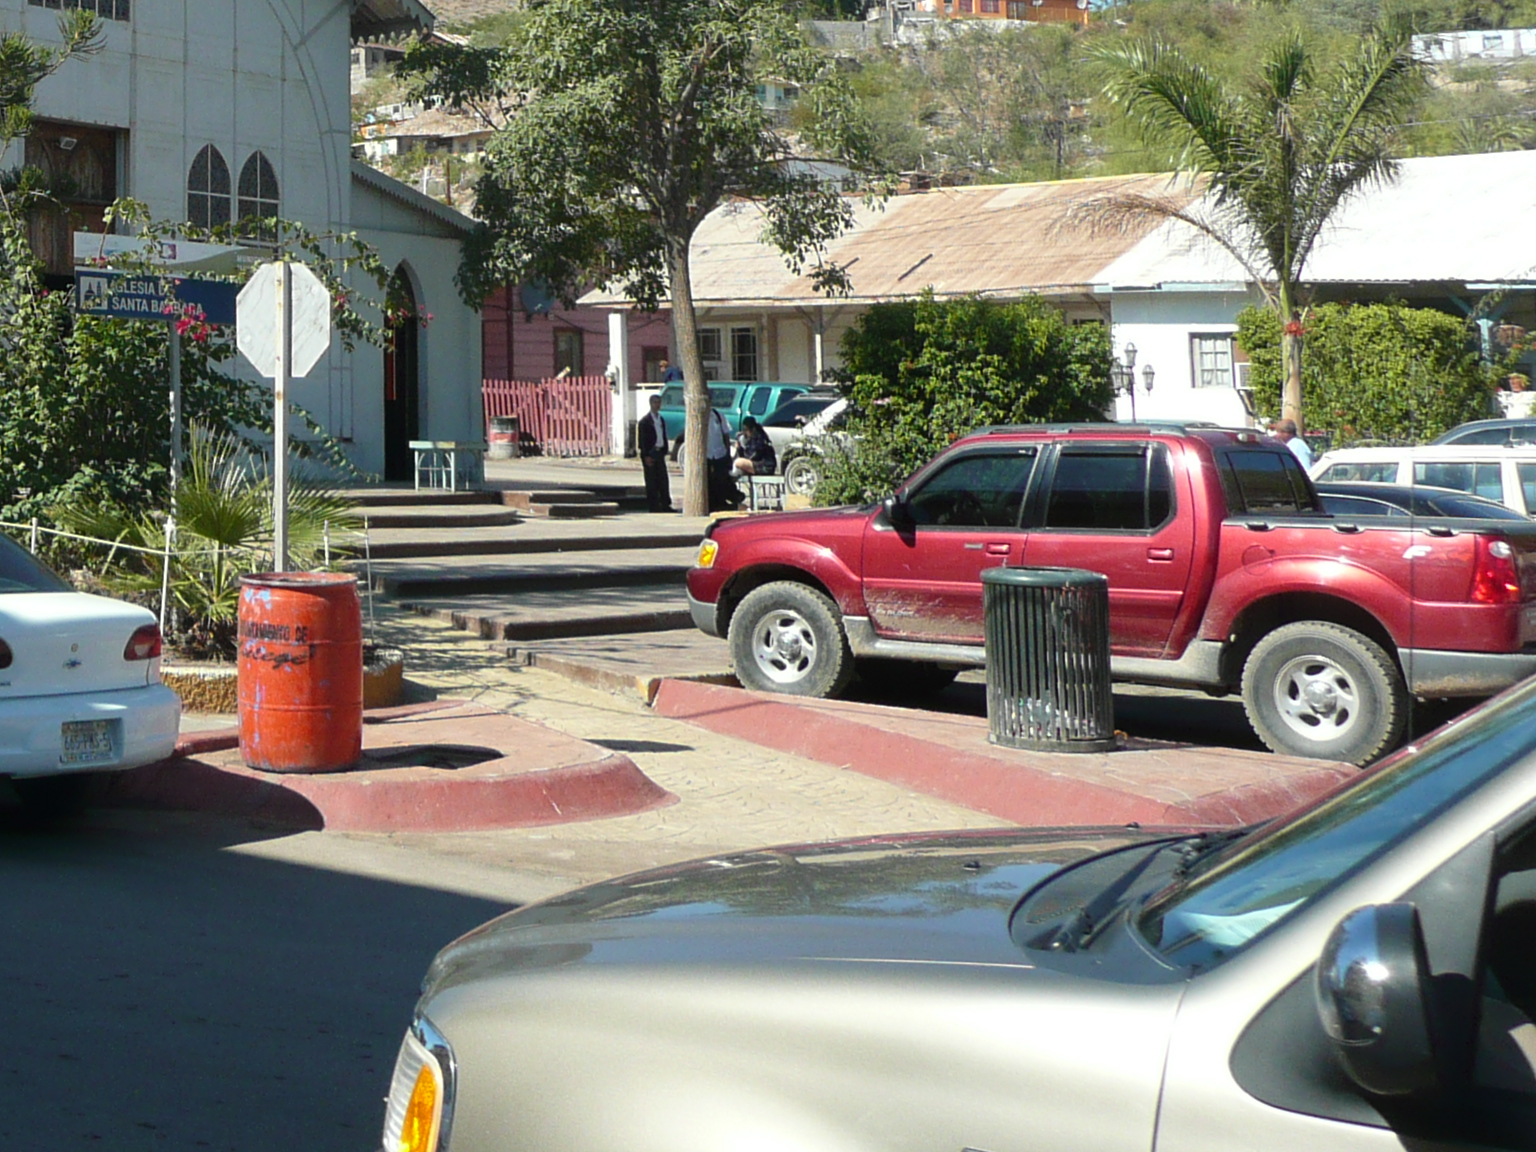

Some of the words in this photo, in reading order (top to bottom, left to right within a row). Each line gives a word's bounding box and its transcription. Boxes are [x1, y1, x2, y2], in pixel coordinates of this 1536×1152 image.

[111, 279, 155, 295] IGLESIA
[158, 281, 173, 296] DE
[112, 297, 149, 312] SANTA
[295, 625, 309, 644] DE
